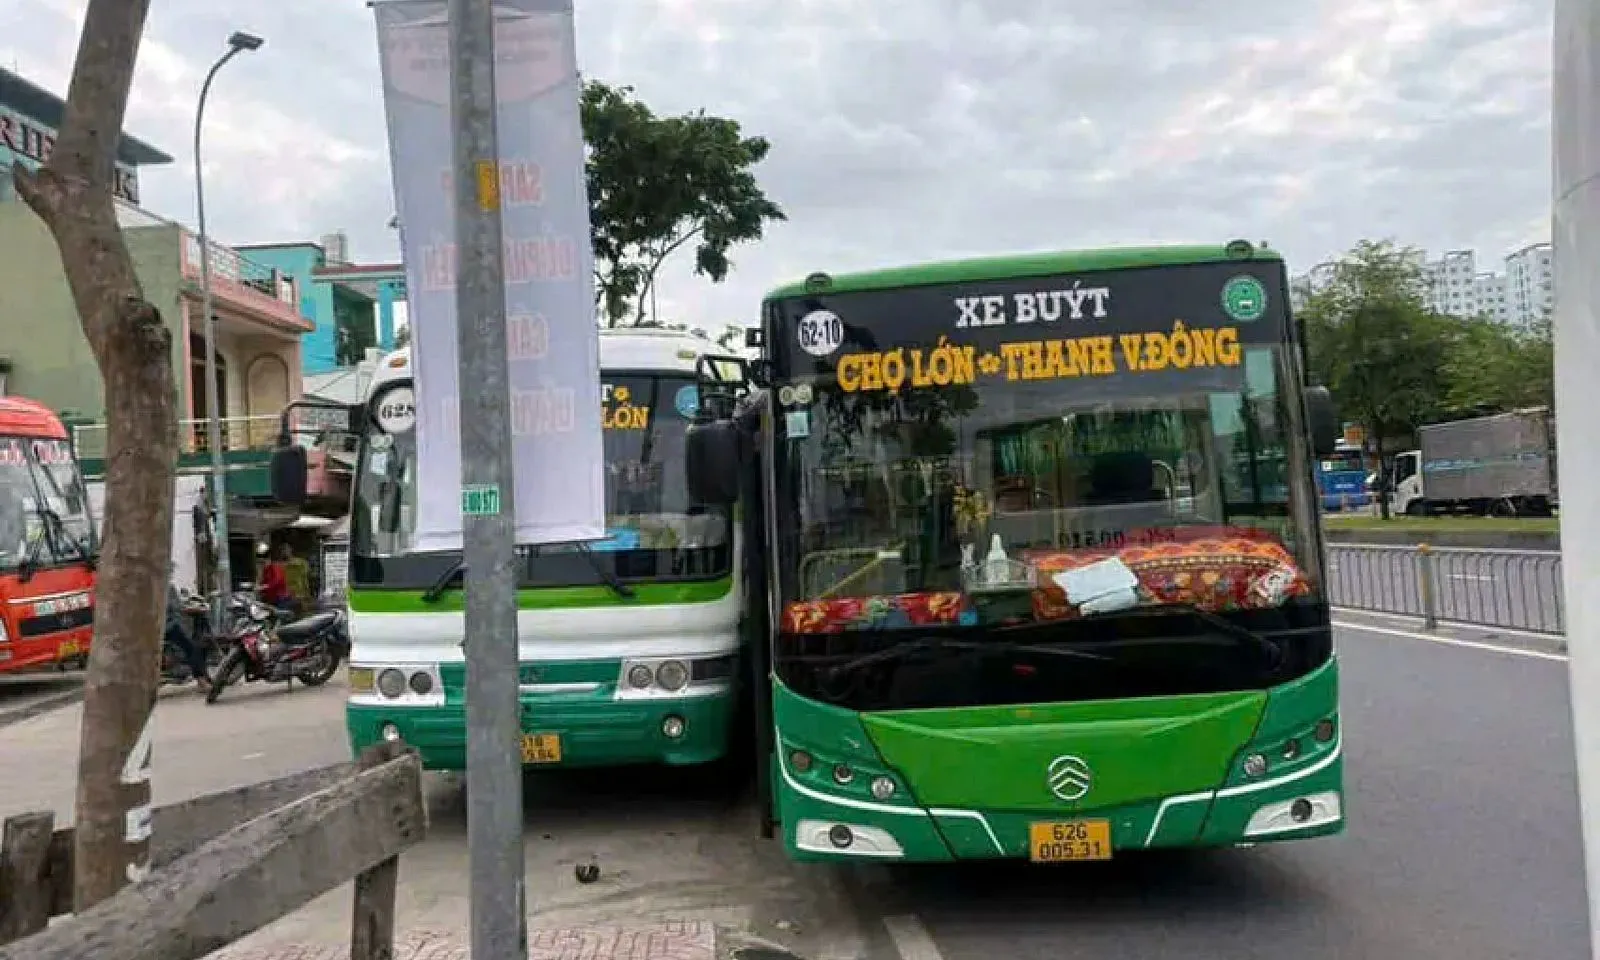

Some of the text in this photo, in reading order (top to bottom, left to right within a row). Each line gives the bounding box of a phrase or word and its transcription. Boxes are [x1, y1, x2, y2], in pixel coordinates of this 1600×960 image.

[955, 280, 1110, 328] XE BUÝT
[801, 318, 841, 346] 62-10
[836, 318, 1242, 395] CHỢ LỚN THANH V.ĐÔNG
[1053, 823, 1088, 841] 62G
